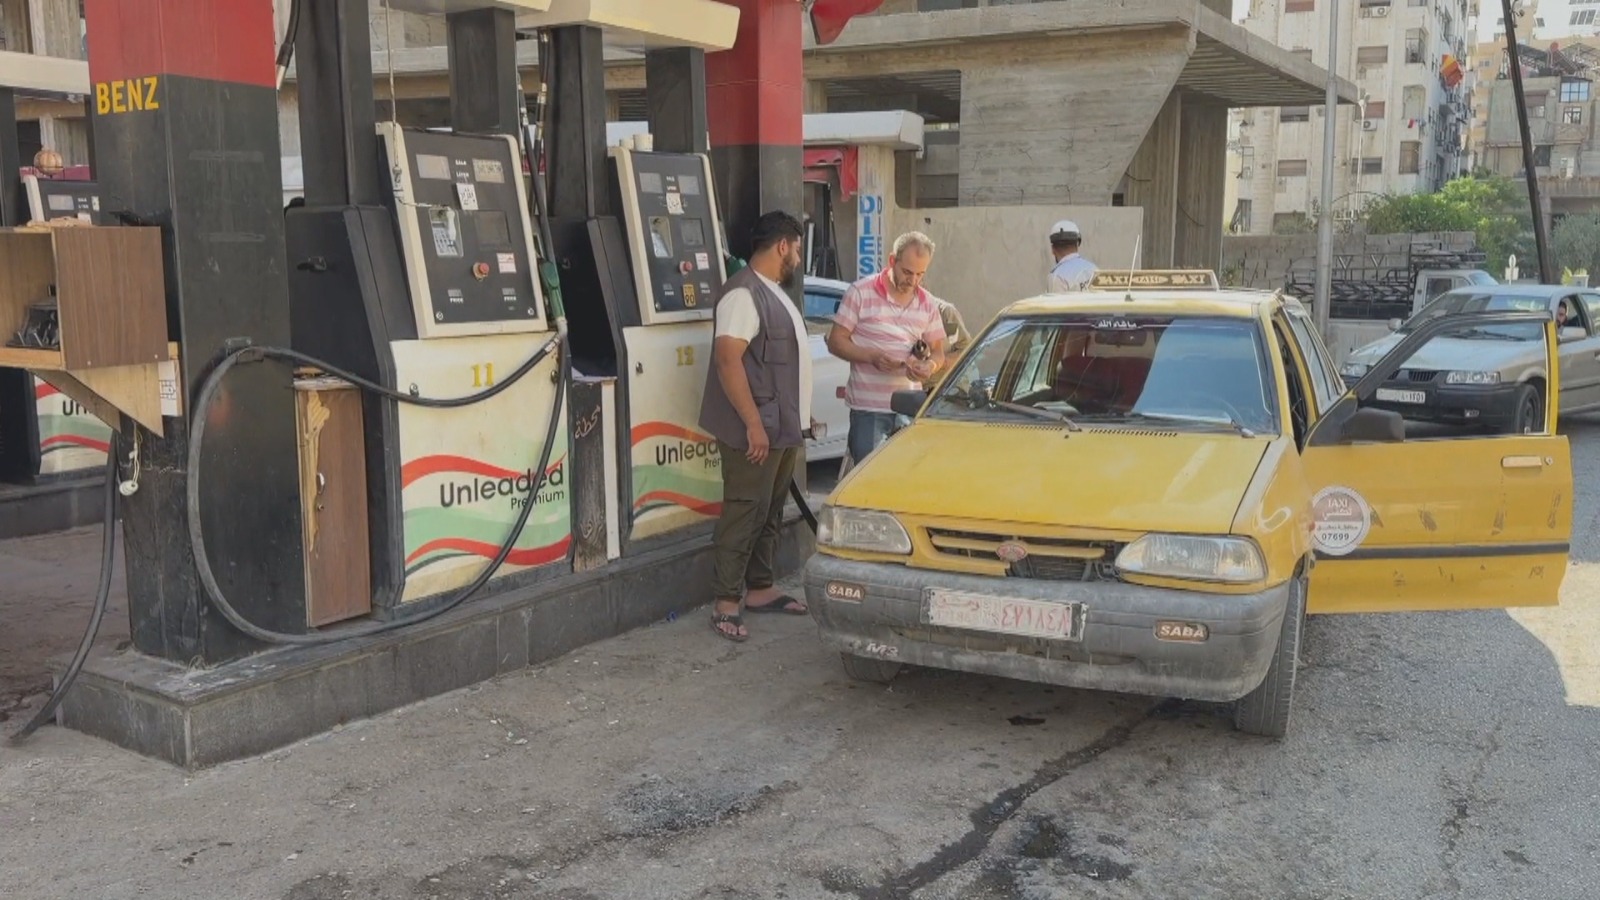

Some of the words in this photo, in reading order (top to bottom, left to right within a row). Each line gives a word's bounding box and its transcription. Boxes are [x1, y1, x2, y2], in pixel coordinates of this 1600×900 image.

[97, 76, 159, 115] BENZ
[859, 195, 876, 281] DIES
[471, 362, 494, 387] 11
[62, 399, 88, 416] Un
[655, 438, 721, 466] Unlead
[704, 457, 720, 469] Pre
[1328, 498, 1349, 508] TAXI
[1321, 532, 1350, 541] 07699
[829, 584, 861, 599] SABA
[1159, 624, 1205, 638] SABA
